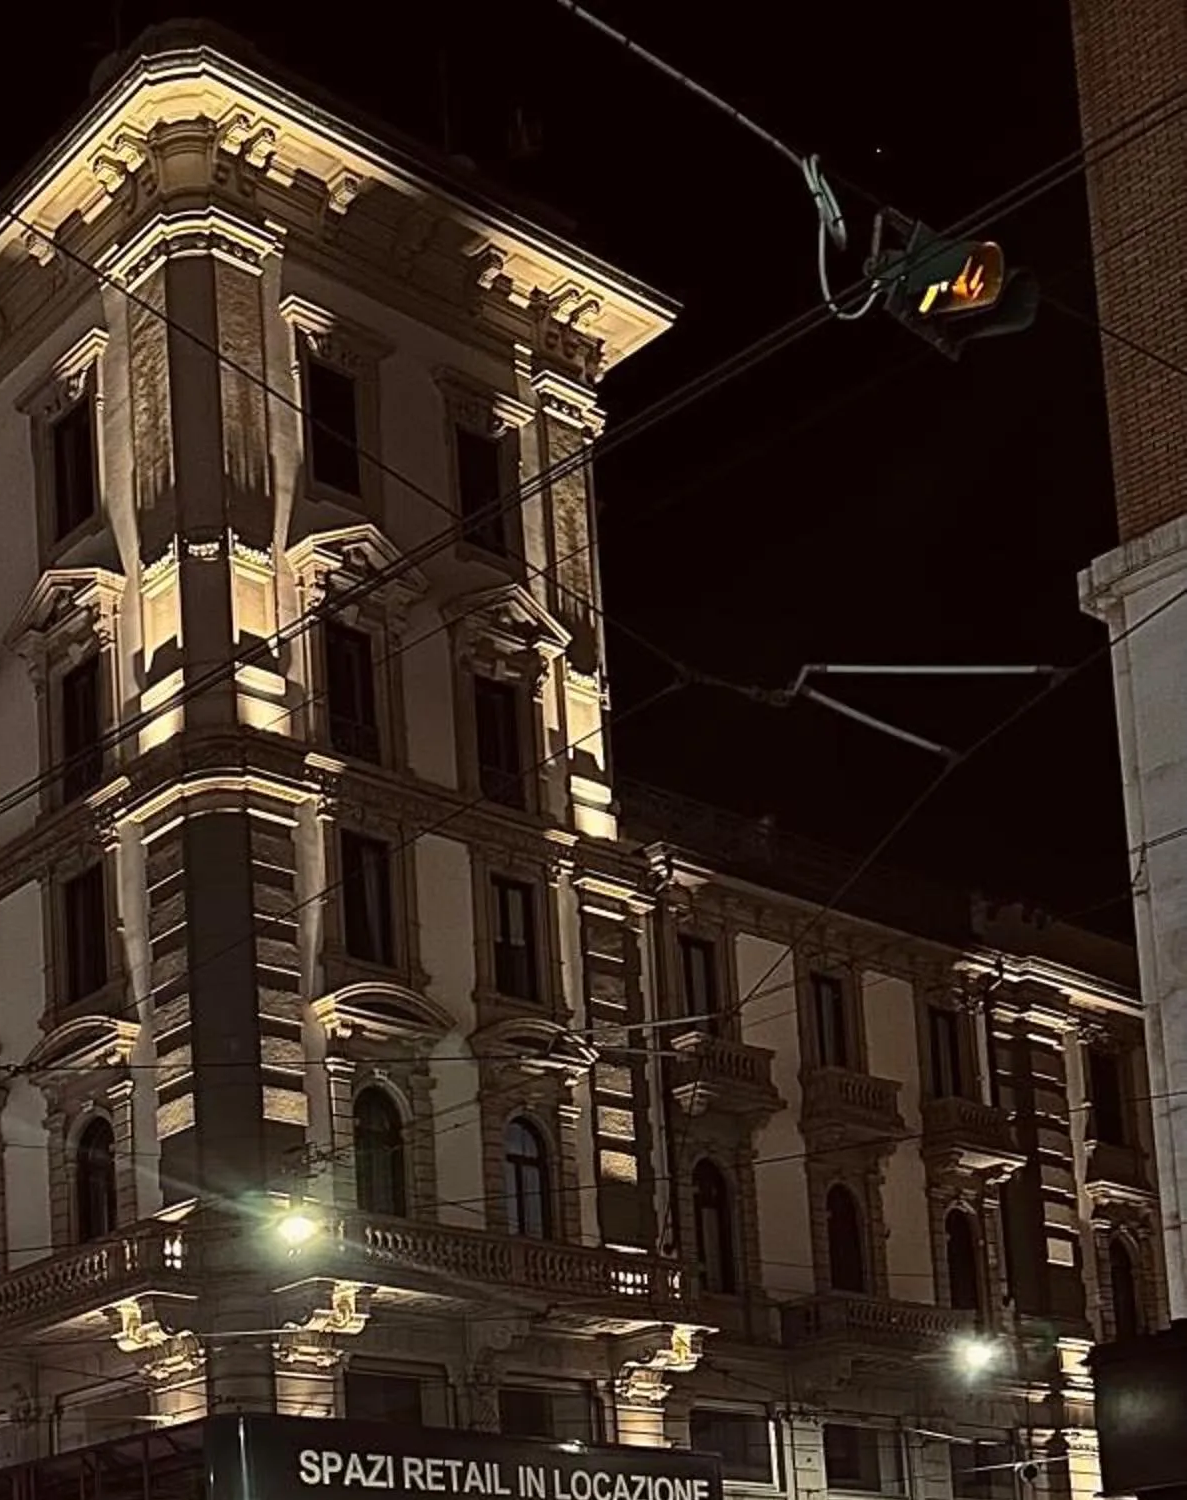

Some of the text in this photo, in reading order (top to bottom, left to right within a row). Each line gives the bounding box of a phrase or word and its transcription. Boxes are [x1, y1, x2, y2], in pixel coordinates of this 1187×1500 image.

[300, 1450, 394, 1488] SPAZI
[403, 1457, 511, 1495] RETAIL
[518, 1466, 546, 1498] IN
